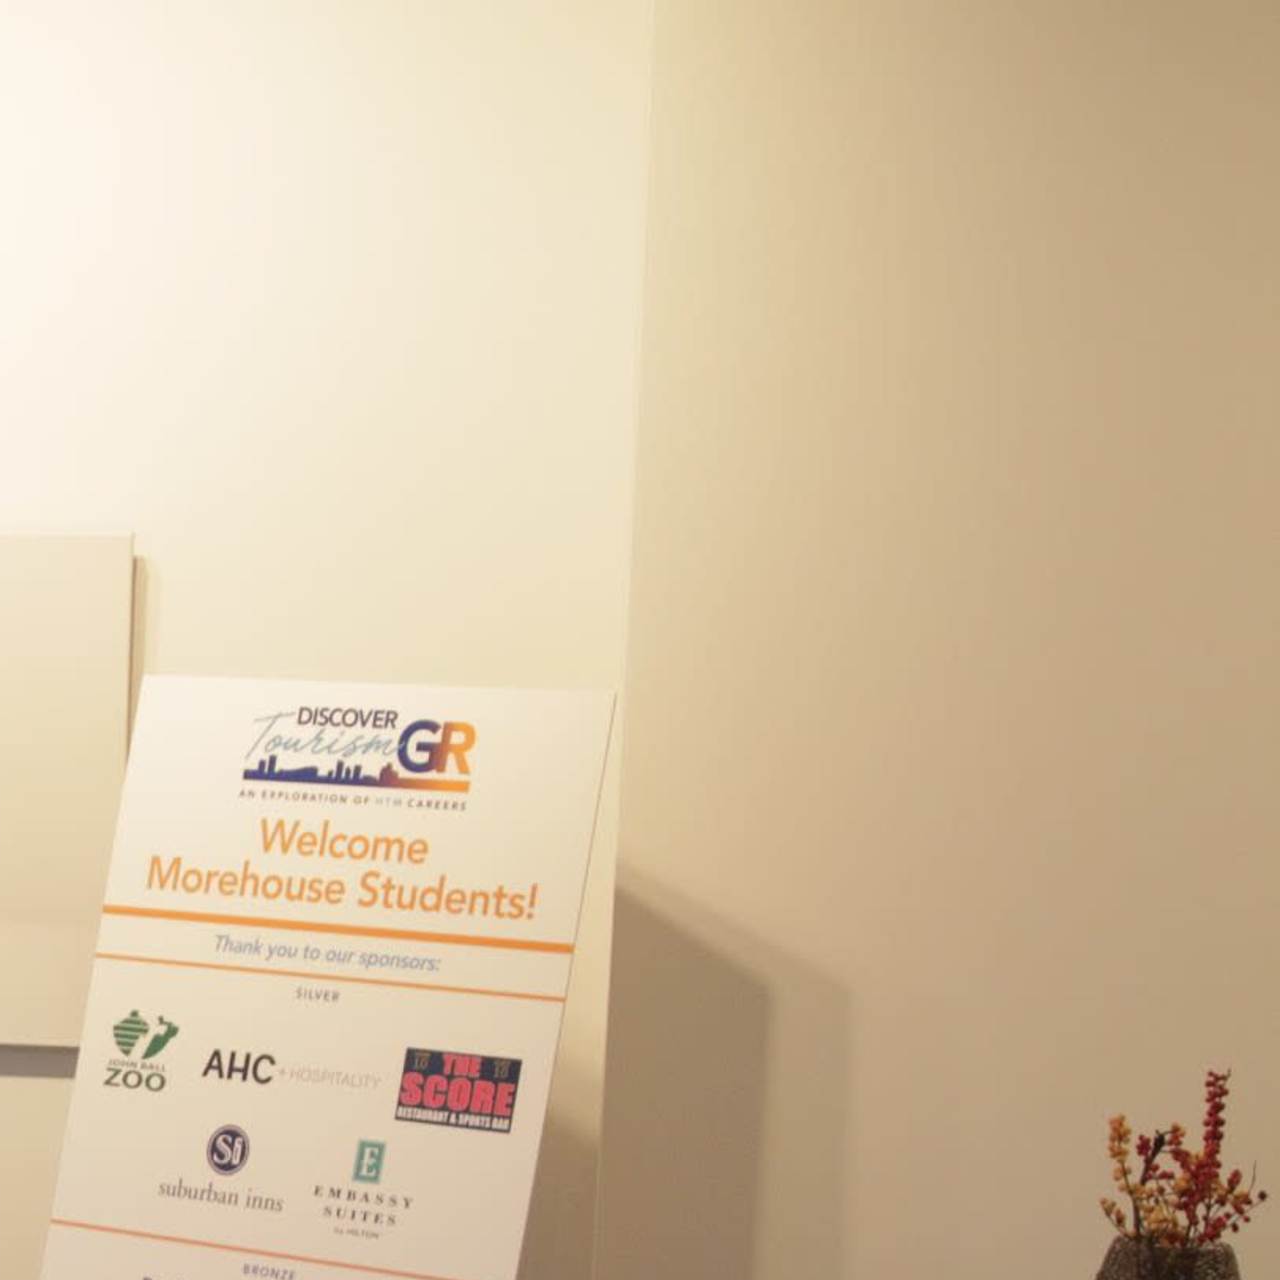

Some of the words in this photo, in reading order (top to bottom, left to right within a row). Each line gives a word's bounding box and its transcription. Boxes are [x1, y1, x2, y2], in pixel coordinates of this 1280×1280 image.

[297, 707, 398, 729] DISCOVER
[245, 711, 406, 759] Tourism
[397, 719, 476, 774] GR
[239, 789, 255, 799] AN
[261, 790, 348, 804] EXPLORATION
[352, 796, 370, 805] OF
[407, 799, 468, 811] CAREERS
[259, 817, 430, 865] Welcome
[146, 855, 347, 905] Morehouse
[357, 870, 539, 920] Students!
[214, 934, 263, 957] Thank
[265, 942, 299, 962] you
[303, 944, 321, 961] to
[325, 948, 356, 965] our
[358, 952, 441, 973] sponsors:
[295, 986, 340, 1003] SILVER
[109, 1059, 137, 1069] JOHN
[202, 1049, 277, 1085] AHC
[289, 1067, 383, 1089] HOSPITALITY
[442, 1052, 482, 1078] THE
[103, 1068, 167, 1092] ZOO
[400, 1071, 516, 1117] SCORE
[361, 1146, 379, 1177] E
[158, 1178, 239, 1207] suburban
[245, 1191, 284, 1213] inns
[314, 1185, 414, 1209] EMBASSY
[323, 1205, 396, 1225] SUITES
